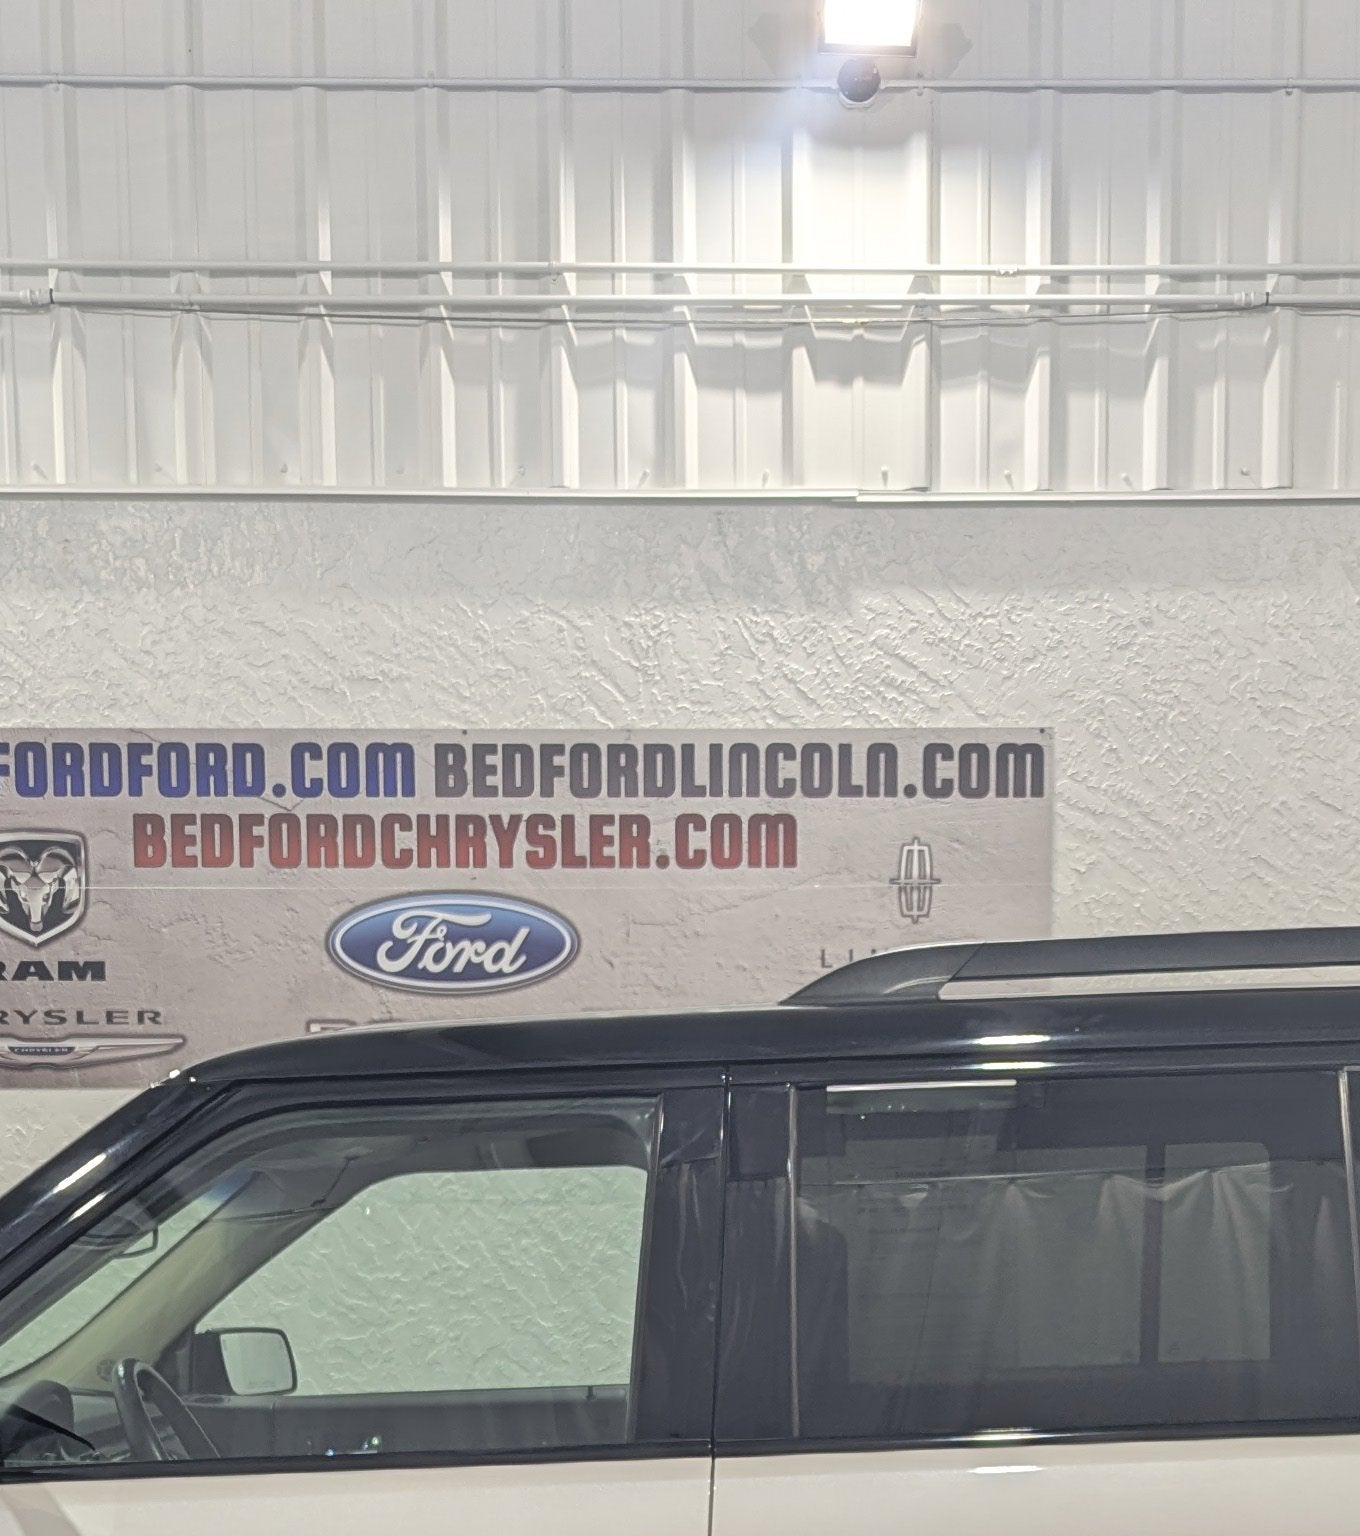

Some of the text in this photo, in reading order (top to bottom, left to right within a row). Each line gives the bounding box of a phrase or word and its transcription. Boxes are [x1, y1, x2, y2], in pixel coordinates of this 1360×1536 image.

[433, 741, 1046, 799] BEDFORDLINCOLN.COM
[133, 812, 798, 869] BEDFORDCHRYSLER.COM
[376, 908, 530, 974] Ford
